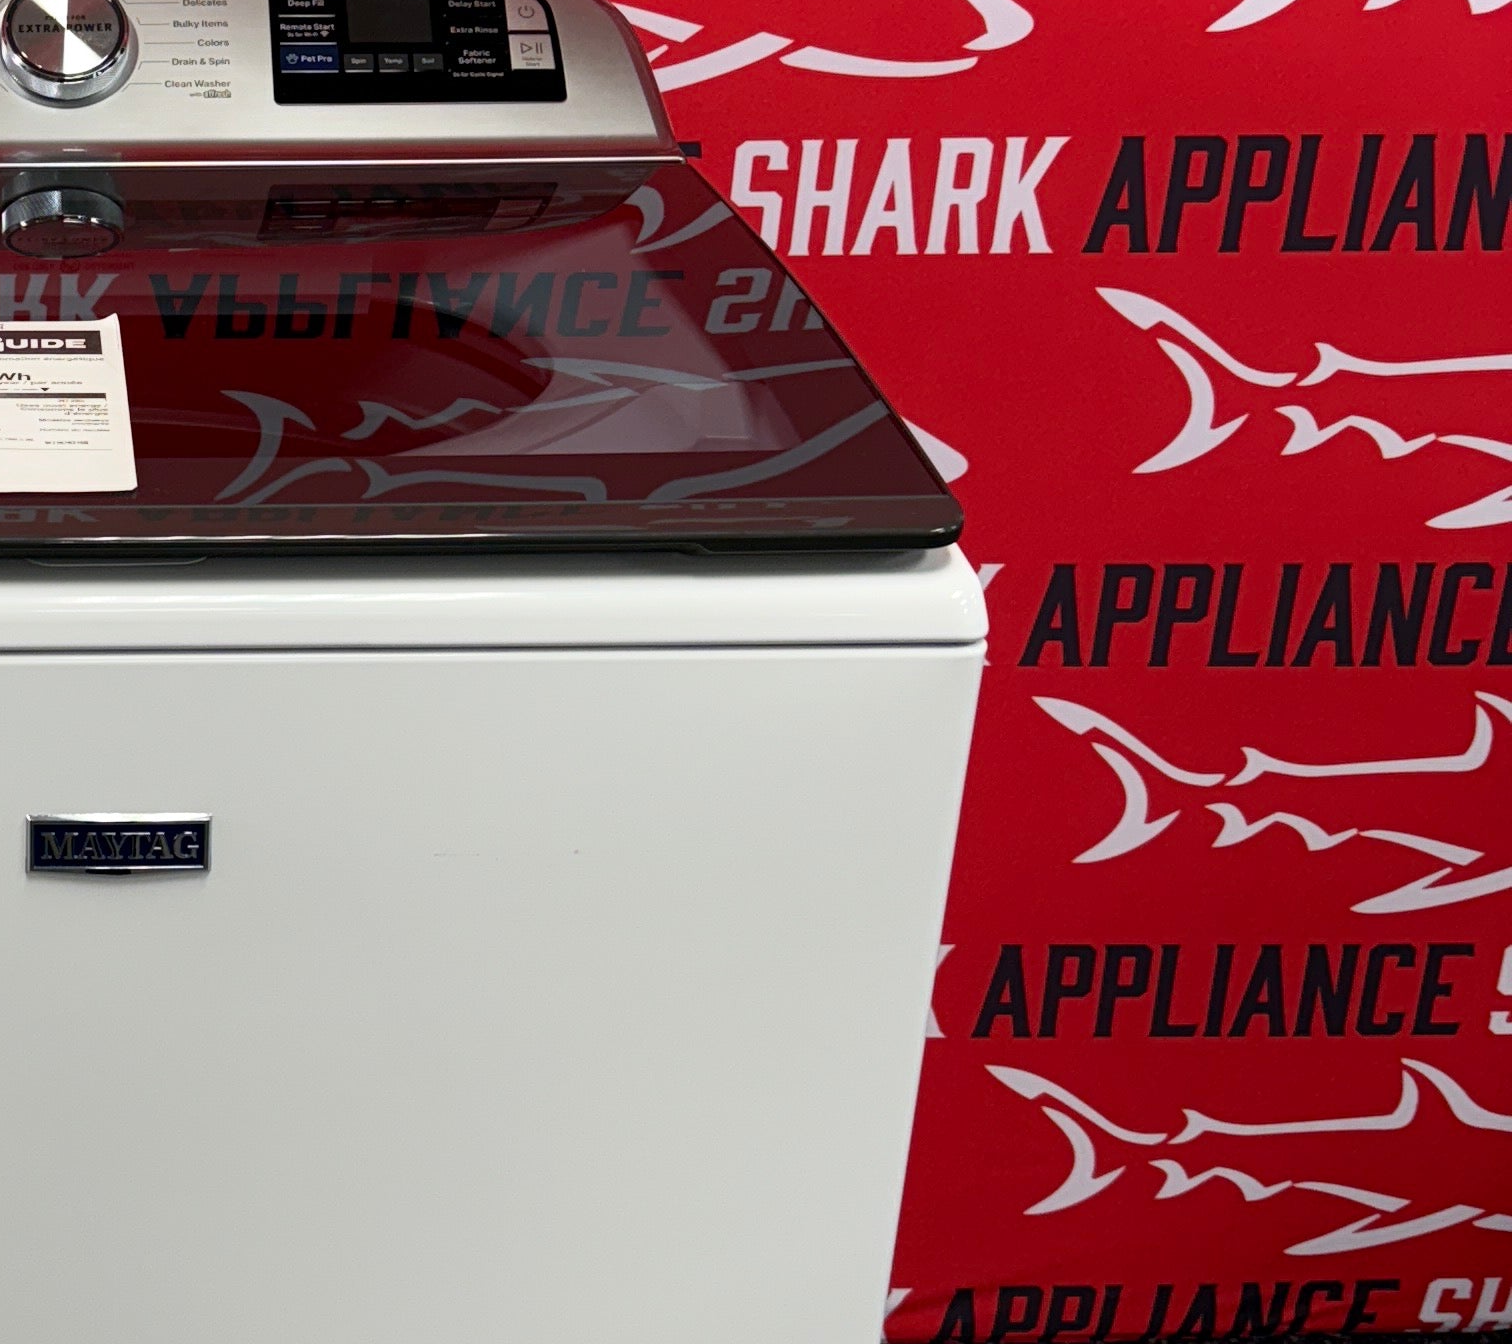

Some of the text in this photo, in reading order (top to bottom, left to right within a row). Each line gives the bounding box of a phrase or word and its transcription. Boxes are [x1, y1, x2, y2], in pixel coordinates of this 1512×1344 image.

[182, 0, 228, 7] Delicates
[288, 0, 310, 7] Deep
[448, 0, 472, 8] Delay
[18, 22, 112, 33] EXTRA POWER
[173, 19, 228, 29] Bulky Items
[280, 22, 335, 31] Remote Start
[450, 26, 499, 34] Extra Rinse
[197, 38, 230, 46] Colors
[463, 49, 490, 57] Fabric
[172, 58, 230, 67] Drain & Spin
[301, 55, 332, 63] Pet Pro
[164, 80, 231, 88] Clean Washer
[730, 133, 1512, 257] SHARK APPLIAN
[41, 830, 200, 860] MAYTAG
[971, 943, 1475, 1039] APPLIANCE
[928, 1278, 1402, 1344] APPLIANCE
